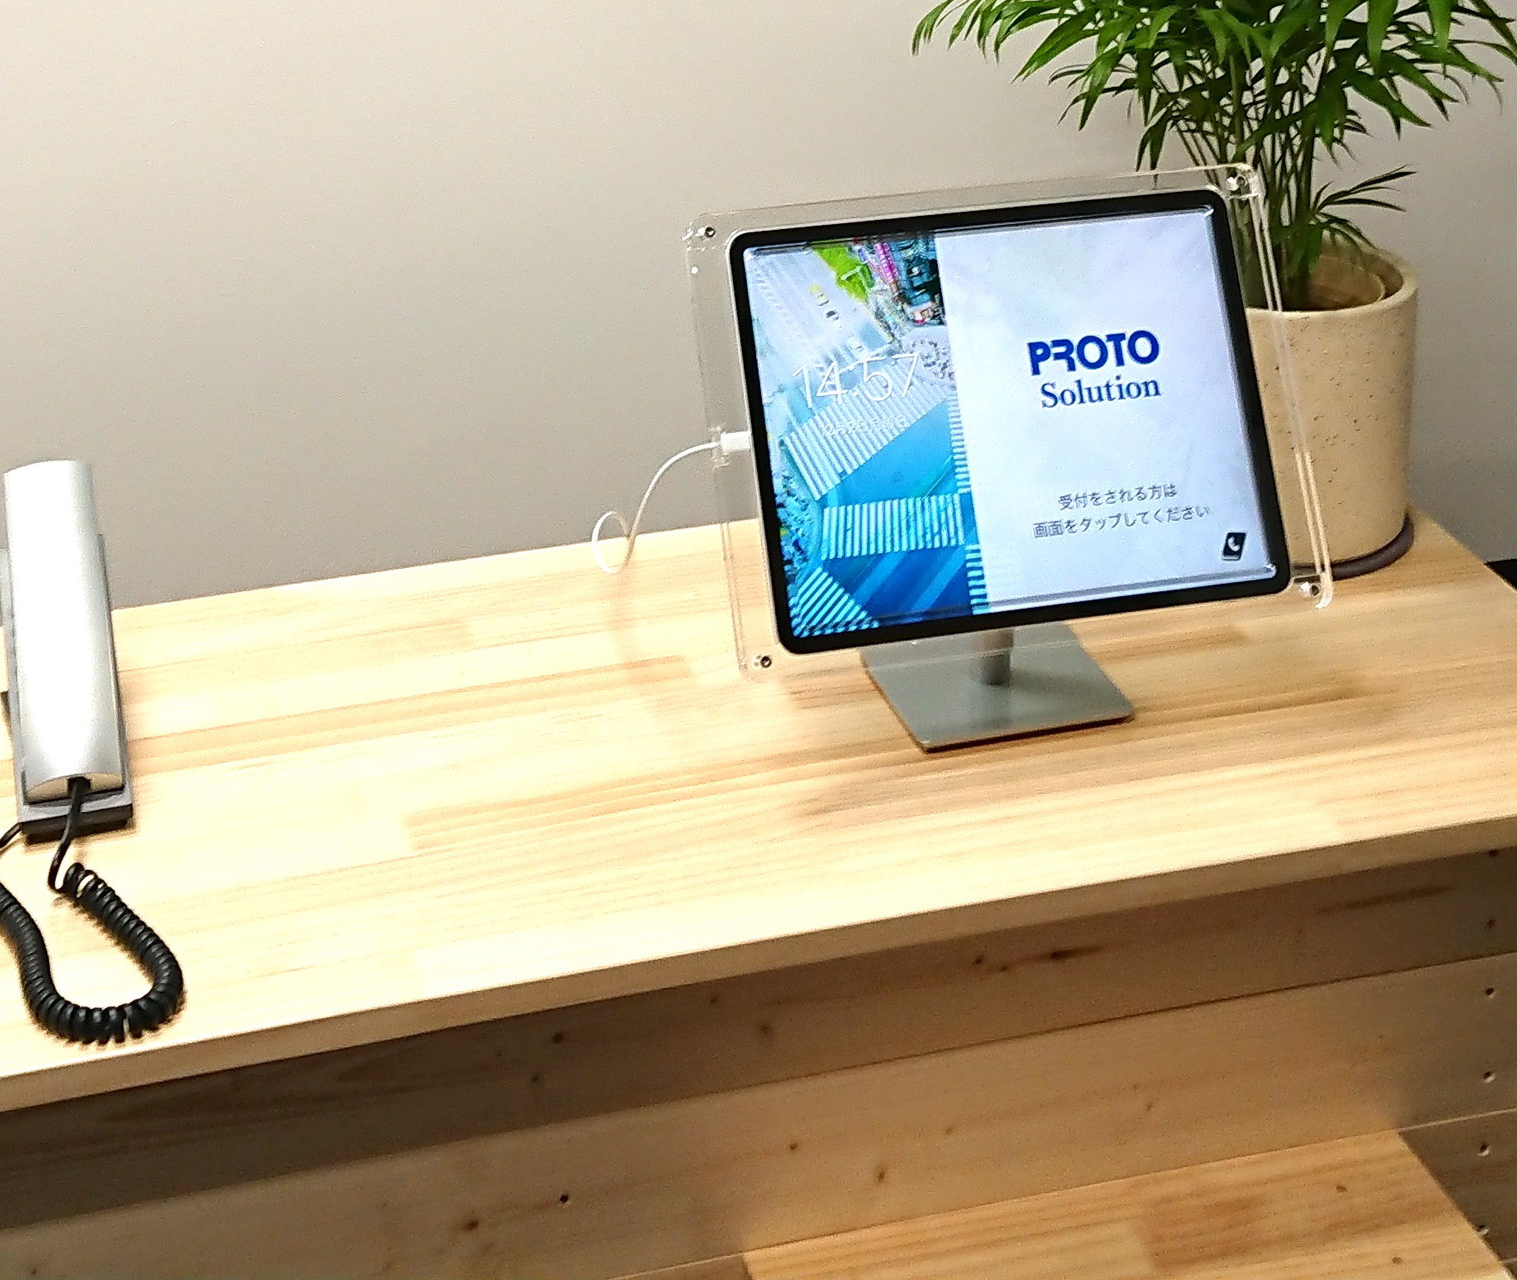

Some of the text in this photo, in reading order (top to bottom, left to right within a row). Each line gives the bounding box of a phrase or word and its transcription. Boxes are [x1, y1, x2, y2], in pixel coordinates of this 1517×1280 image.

[1027, 330, 1160, 376] PROTO
[793, 353, 919, 409] 14:57
[1040, 374, 1162, 409] Solution
[1057, 483, 1178, 511] 受付をされる方は
[1033, 505, 1211, 538] 画面をタップしてください
